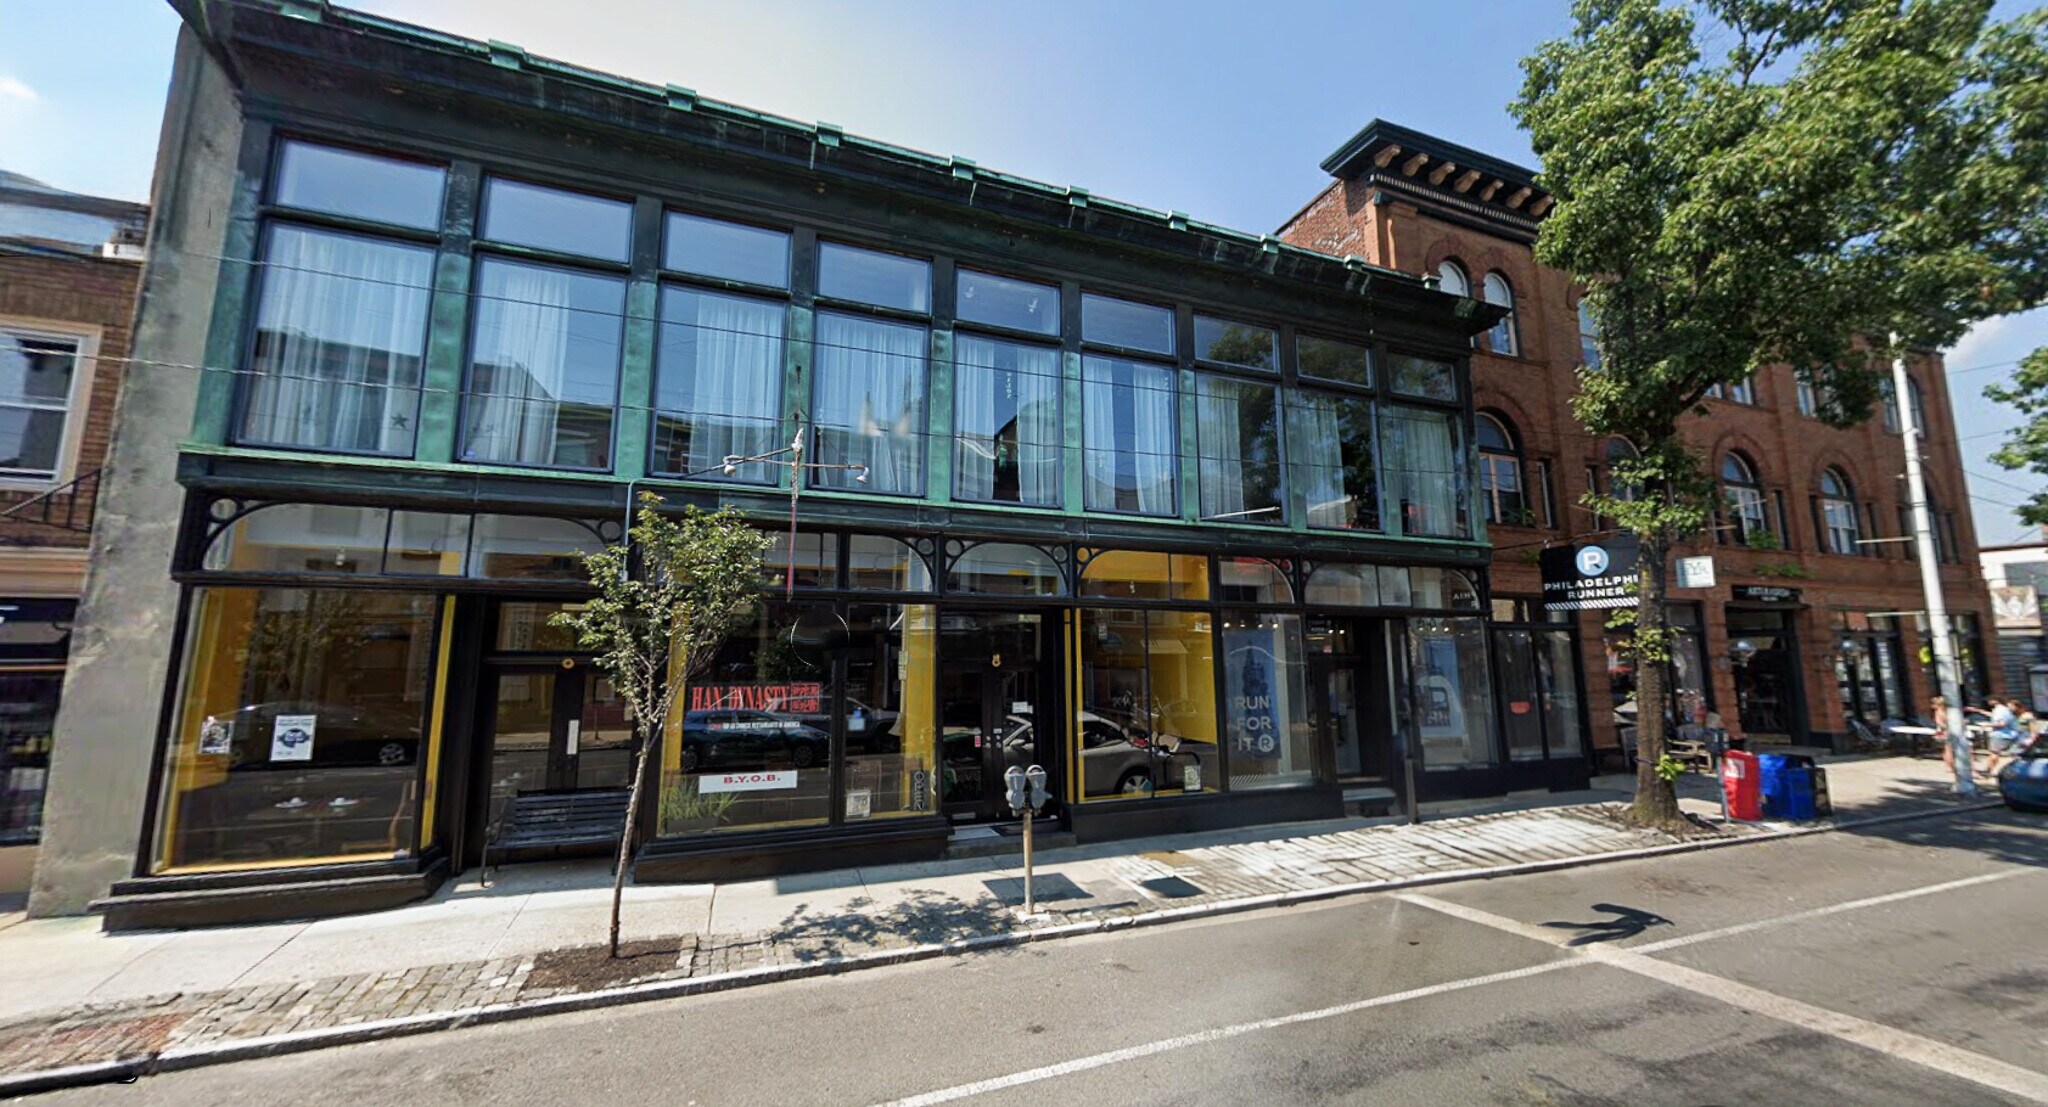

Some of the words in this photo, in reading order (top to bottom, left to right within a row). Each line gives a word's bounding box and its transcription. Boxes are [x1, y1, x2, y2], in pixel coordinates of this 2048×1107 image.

[1544, 574, 1639, 591] PHILADELPHI
[1568, 586, 1625, 599] RUNNER
[691, 686, 724, 712] HAN
[728, 685, 791, 711] DYNASTY
[1233, 696, 1270, 710] RUN
[1236, 715, 1272, 730] FOR
[1238, 737, 1254, 751] IT
[723, 774, 781, 784] B.Y.O.B.
[913, 770, 925, 811] OPEN
